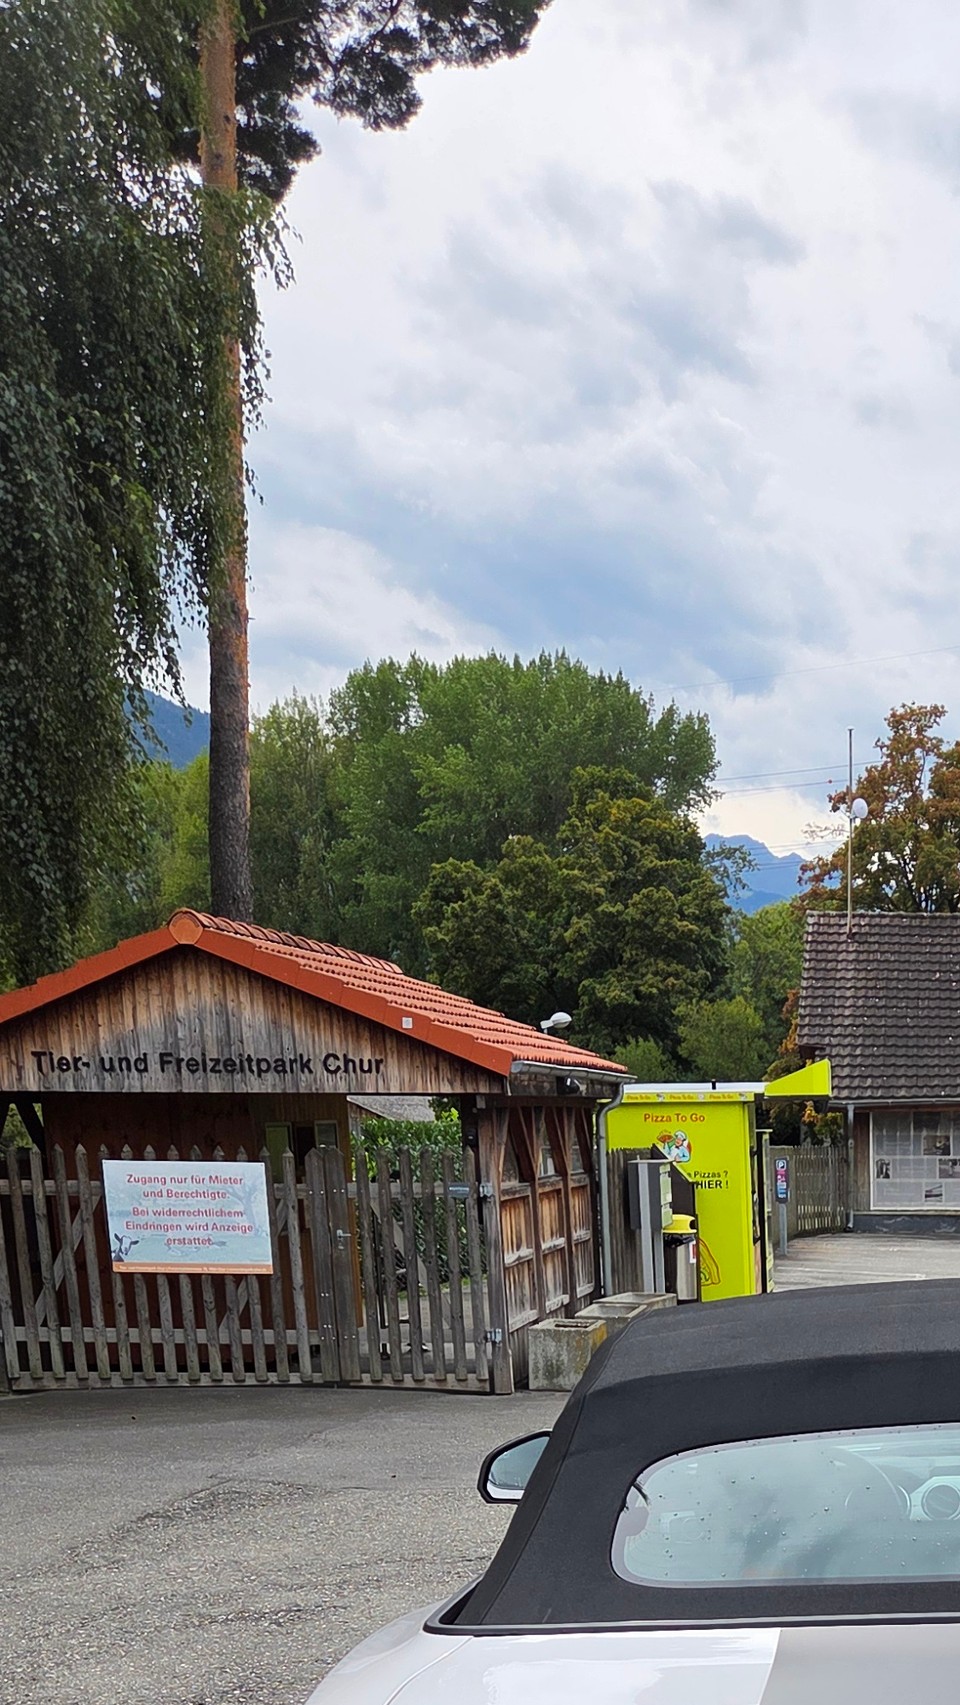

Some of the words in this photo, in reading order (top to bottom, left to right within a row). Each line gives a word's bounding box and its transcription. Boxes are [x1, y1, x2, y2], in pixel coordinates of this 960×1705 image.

[31, 1051, 90, 1075] Tier-
[100, 1052, 149, 1074] und
[159, 1052, 313, 1078] Freizeitpark
[323, 1053, 383, 1074] Chur
[644, 1113, 672, 1122] Pizza
[675, 1113, 687, 1122] To
[690, 1113, 705, 1122] Go
[127, 1174, 166, 1185] Zugang
[191, 1175, 205, 1184] für
[208, 1175, 243, 1185] Mieter
[695, 1180, 723, 1189] HIER
[143, 1189, 163, 1198] und
[166, 1190, 230, 1199] Berechtigte.
[132, 1207, 149, 1216] Bei
[152, 1208, 243, 1217] widerrechtlichem
[126, 1221, 182, 1232] Eindringen
[185, 1222, 209, 1231] wird
[211, 1223, 253, 1233] Anzeige
